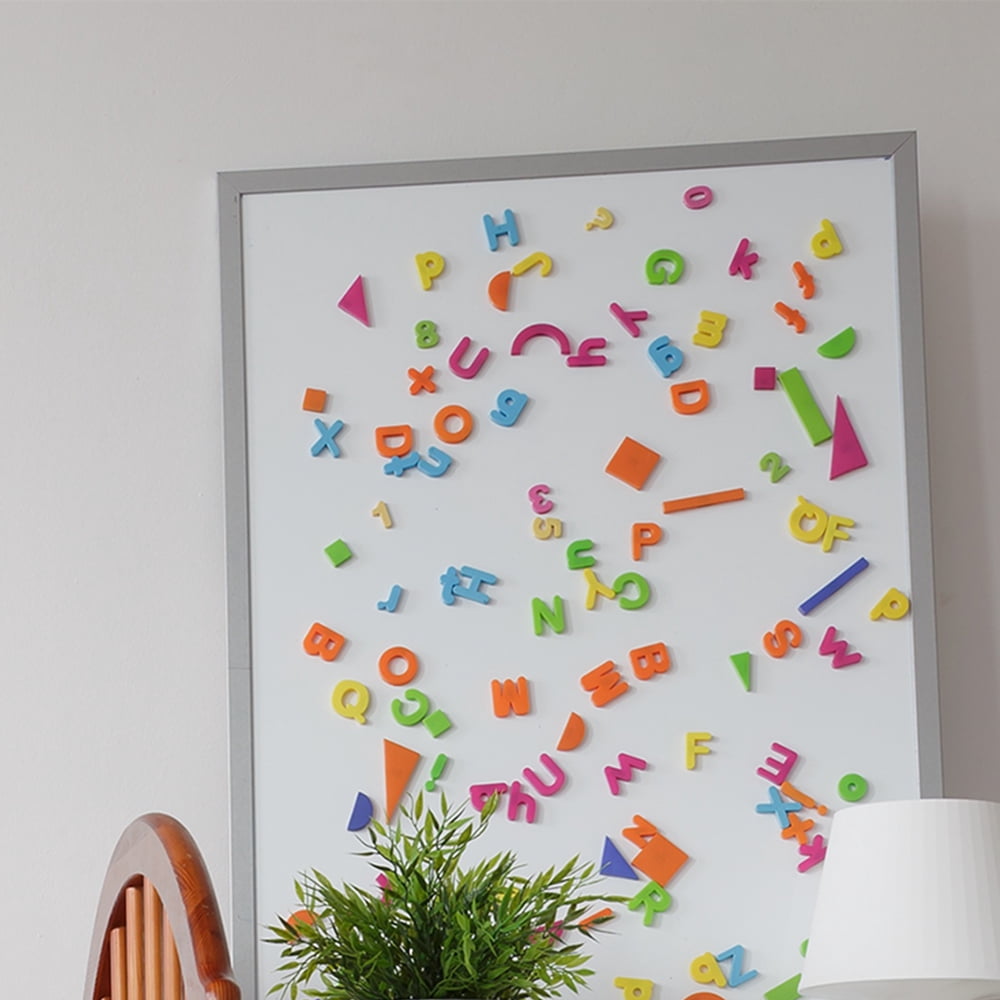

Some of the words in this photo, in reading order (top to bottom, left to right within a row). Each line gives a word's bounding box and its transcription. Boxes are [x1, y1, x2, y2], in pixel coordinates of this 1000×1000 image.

[483, 210, 519, 251] H
[645, 250, 684, 285] G
[670, 380, 710, 415] D
[375, 425, 414, 458] D
[760, 453, 789, 483] 2
[632, 523, 663, 561] P
[612, 572, 650, 610] C
[532, 596, 565, 635] N
[303, 623, 346, 662] B
[763, 620, 803, 658] S
[629, 643, 671, 680] B
[332, 680, 370, 724] Q
[686, 732, 712, 770] F
[626, 882, 671, 926] R
